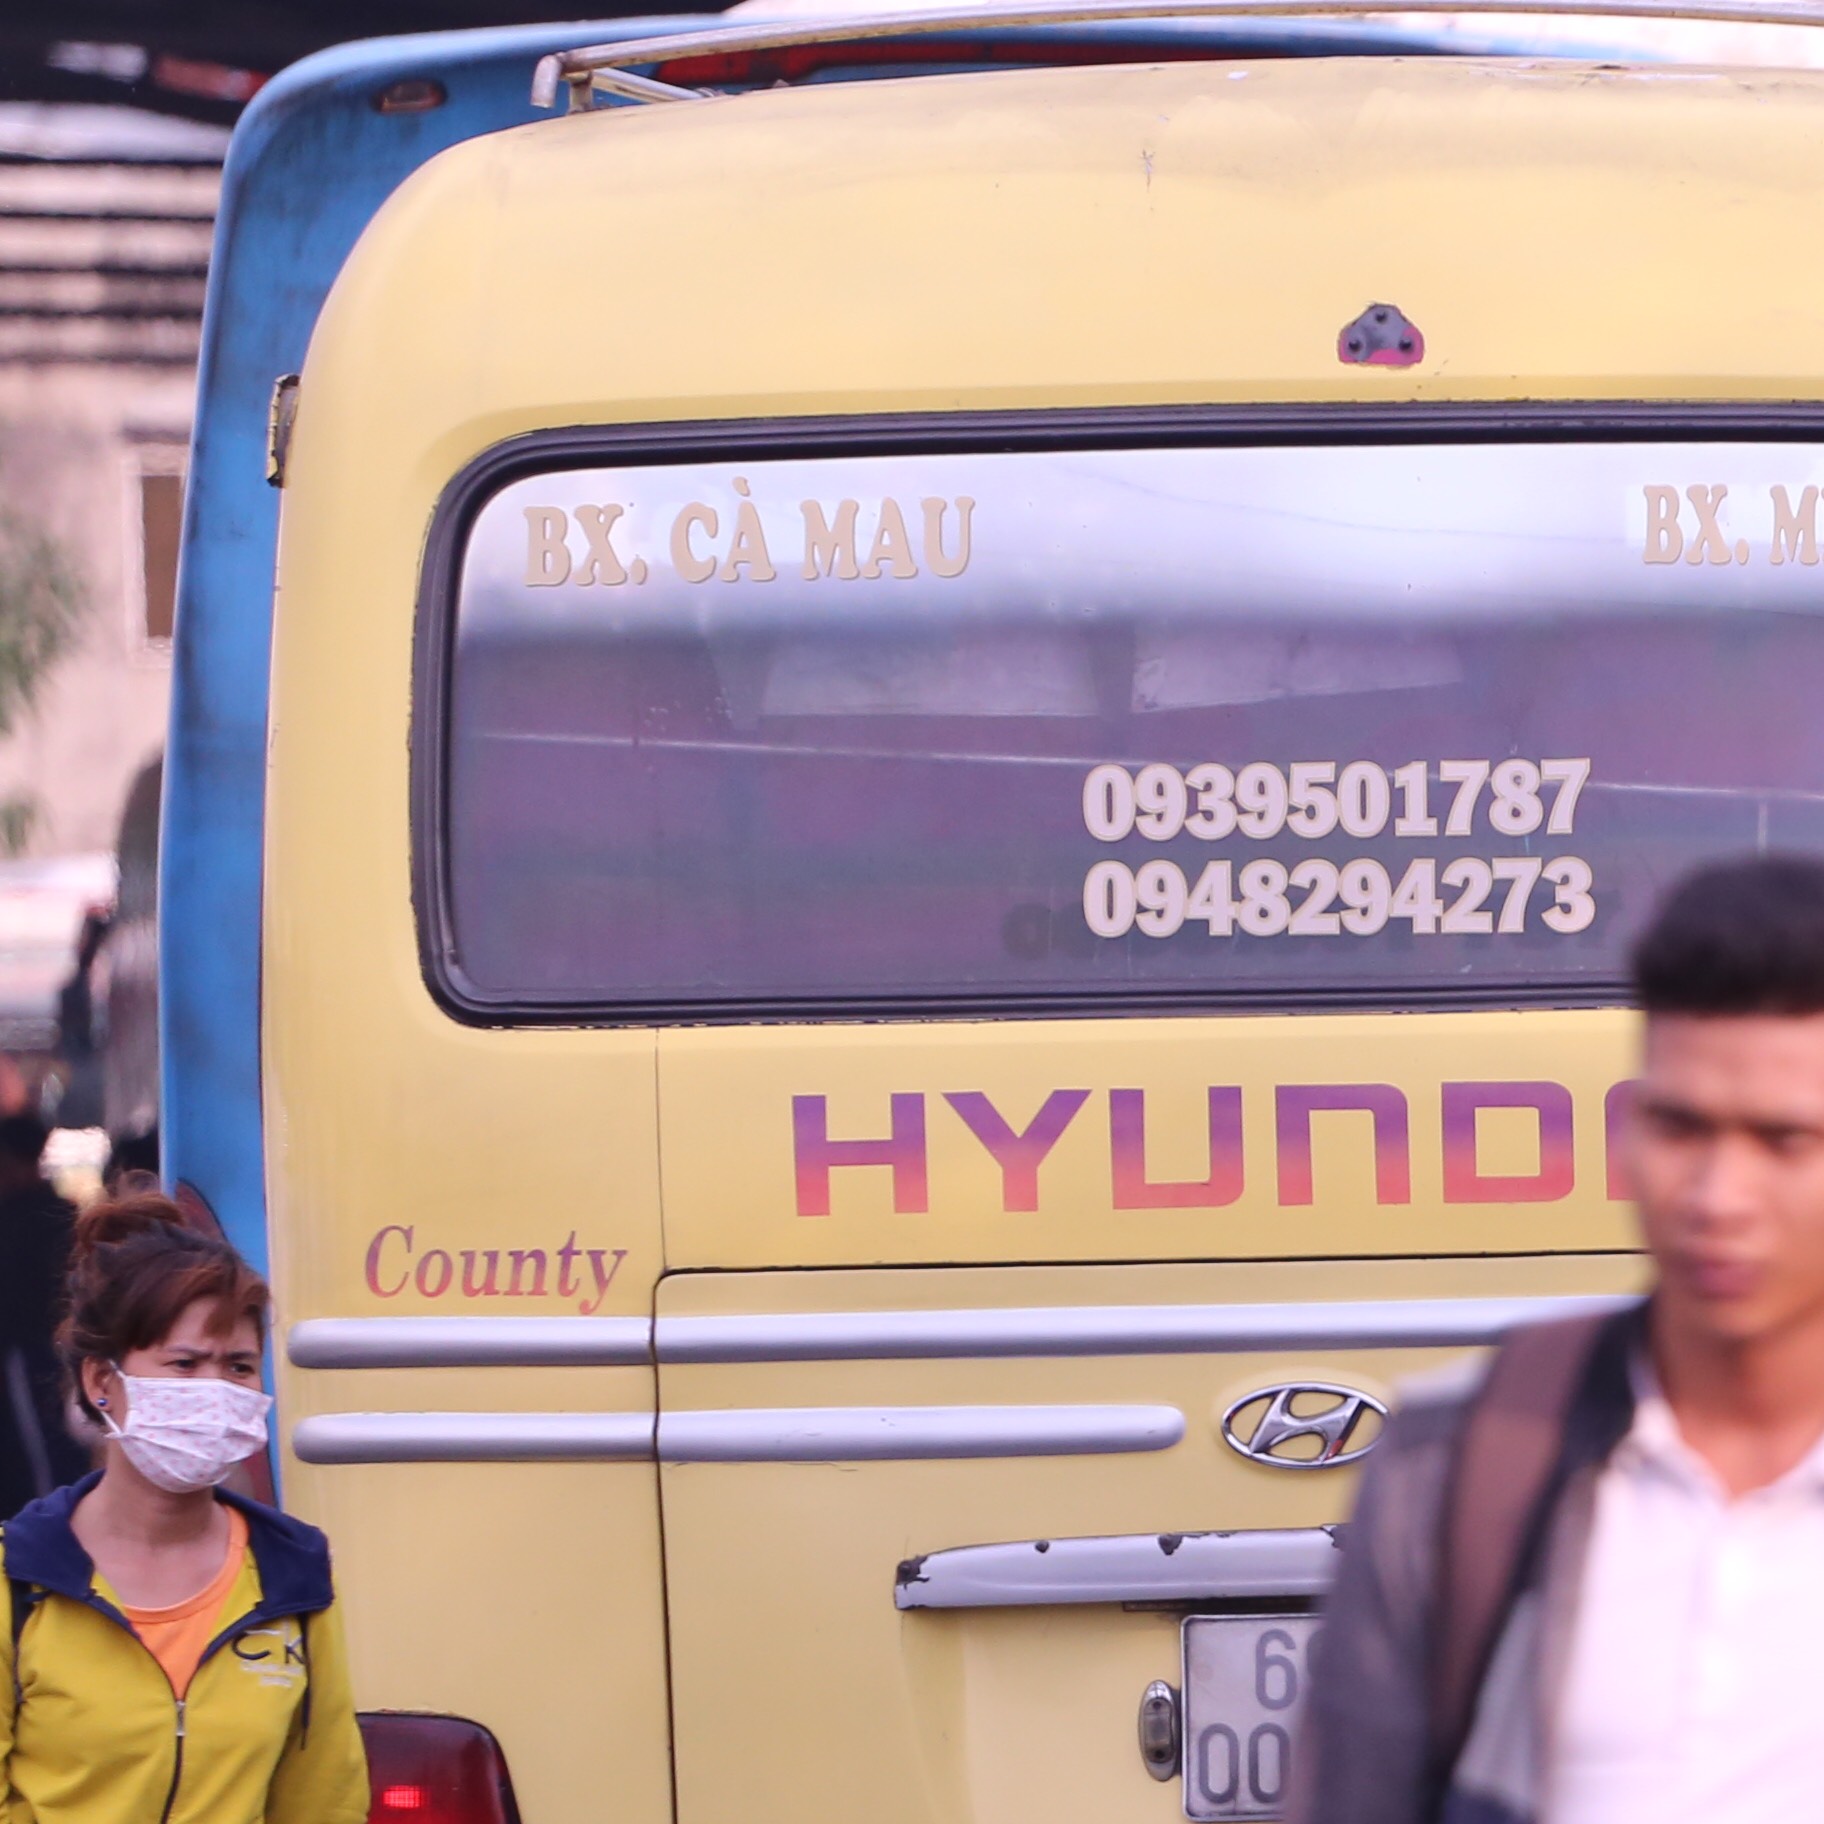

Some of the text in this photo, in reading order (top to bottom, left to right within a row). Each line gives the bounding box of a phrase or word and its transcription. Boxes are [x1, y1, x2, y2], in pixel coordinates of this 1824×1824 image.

[522, 476, 976, 588] BX. CÀ MAU
[1643, 483, 1751, 567] BX.
[1082, 758, 1592, 842] 0939501787
[1082, 857, 1597, 938] 0948294273
[790, 1080, 1642, 1218] HYUND
[363, 1224, 628, 1315] County
